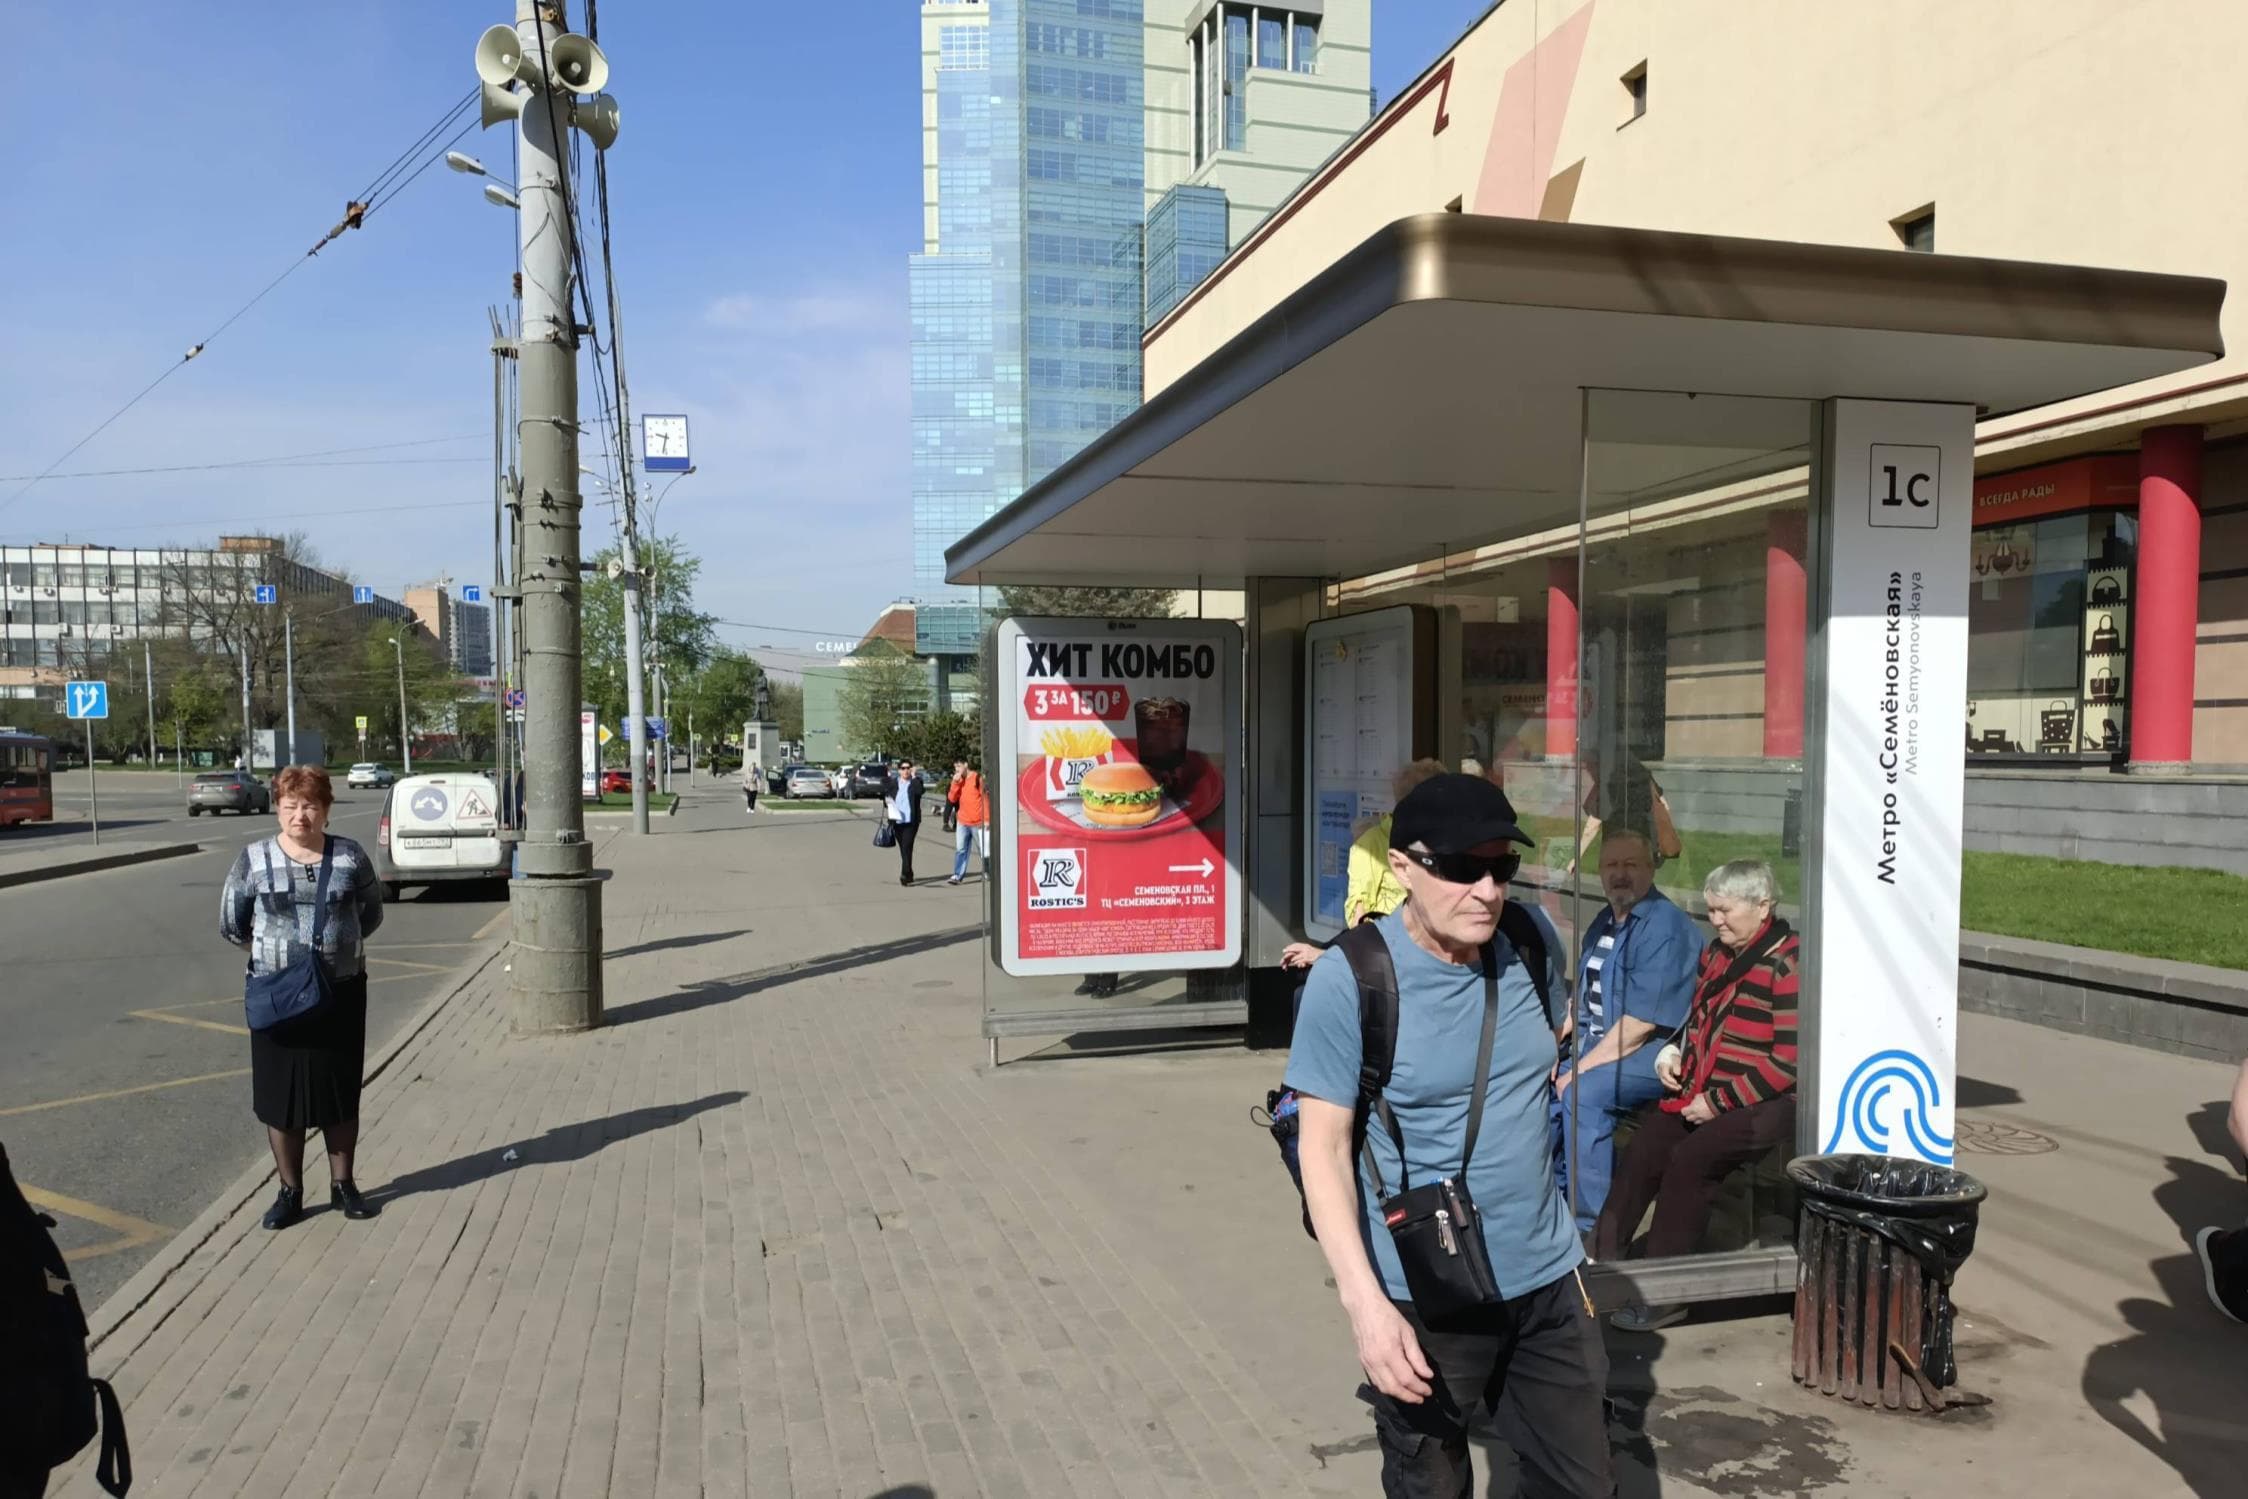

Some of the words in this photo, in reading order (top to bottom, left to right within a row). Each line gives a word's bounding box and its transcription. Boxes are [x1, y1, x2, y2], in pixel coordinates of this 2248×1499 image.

[1979, 490, 2019, 507] ВСЕГДА
[2022, 483, 2056, 500] РАДЫ
[1905, 571, 1923, 714] Semyonovskaya
[1026, 643, 1093, 677] ХИТ
[1101, 643, 1215, 679] КОМБО
[1879, 571, 1903, 785] «Семёновская»
[1034, 690, 1049, 715] 3
[1051, 690, 1068, 705] ЗА
[1070, 690, 1109, 715] 150
[1904, 719, 1920, 776] Metro
[1877, 793, 1901, 885] Метро
[1030, 897, 1085, 907] ROSTIC'S
[1101, 899, 1112, 909] ТЦ
[1192, 895, 1216, 905] ЭТАЖ
[1134, 886, 1192, 896] СЕМЕНОВСКАЯ
